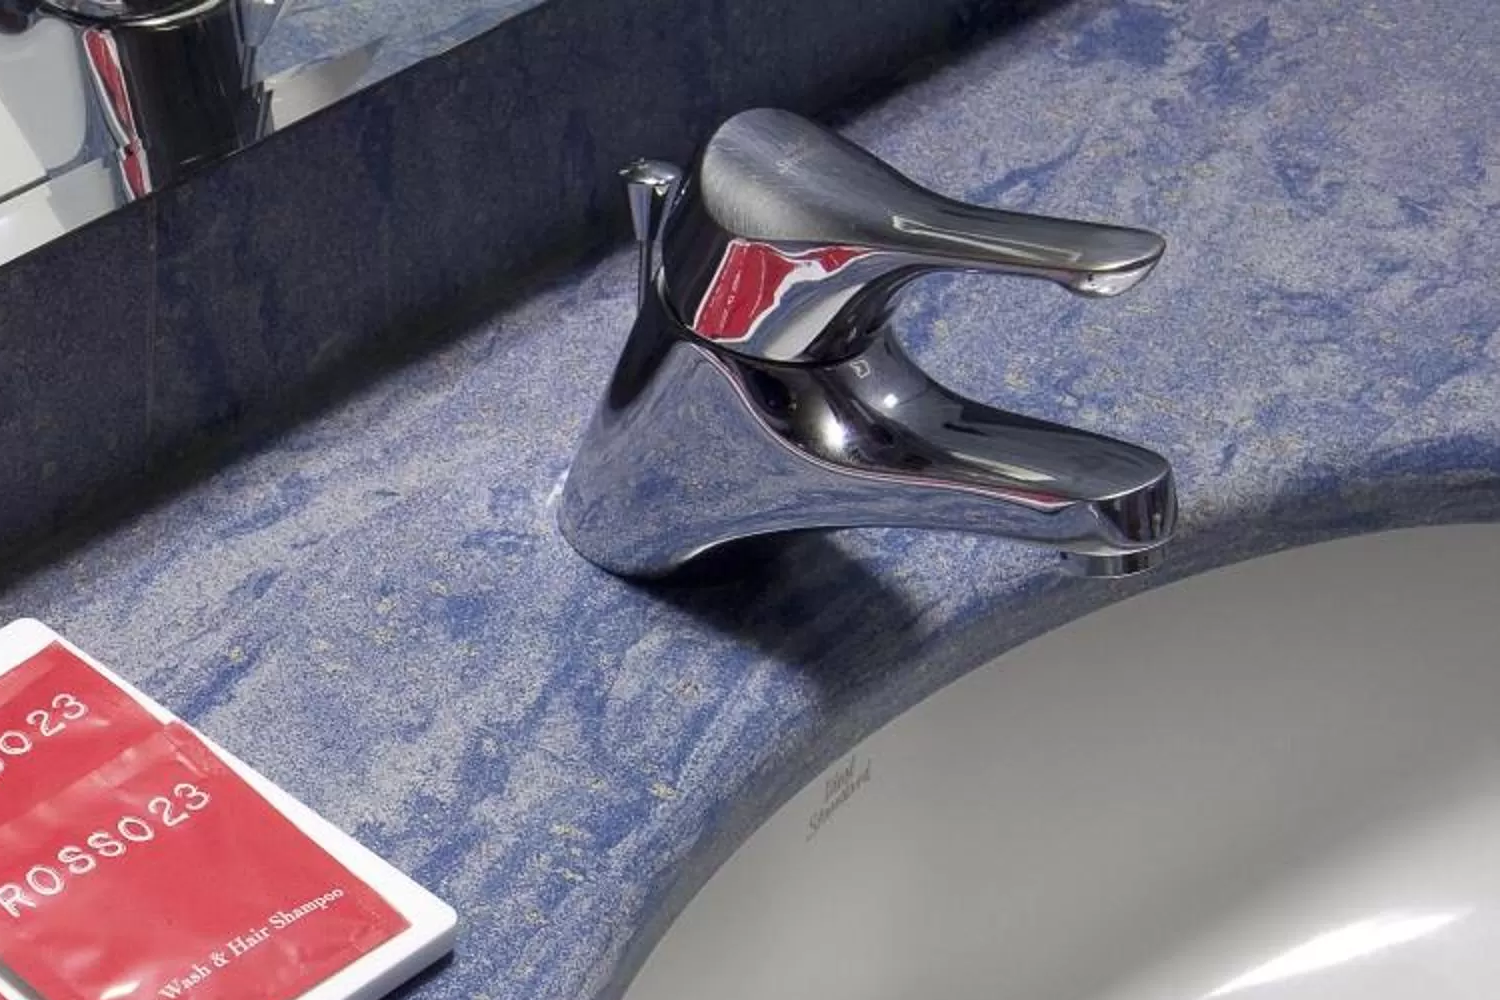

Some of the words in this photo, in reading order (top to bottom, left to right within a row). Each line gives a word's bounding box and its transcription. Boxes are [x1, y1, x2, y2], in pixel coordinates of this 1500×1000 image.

[158, 963, 212, 1000] Wash
[208, 950, 230, 968] &
[227, 925, 271, 957] Hair
[268, 887, 344, 929] Shampoo
